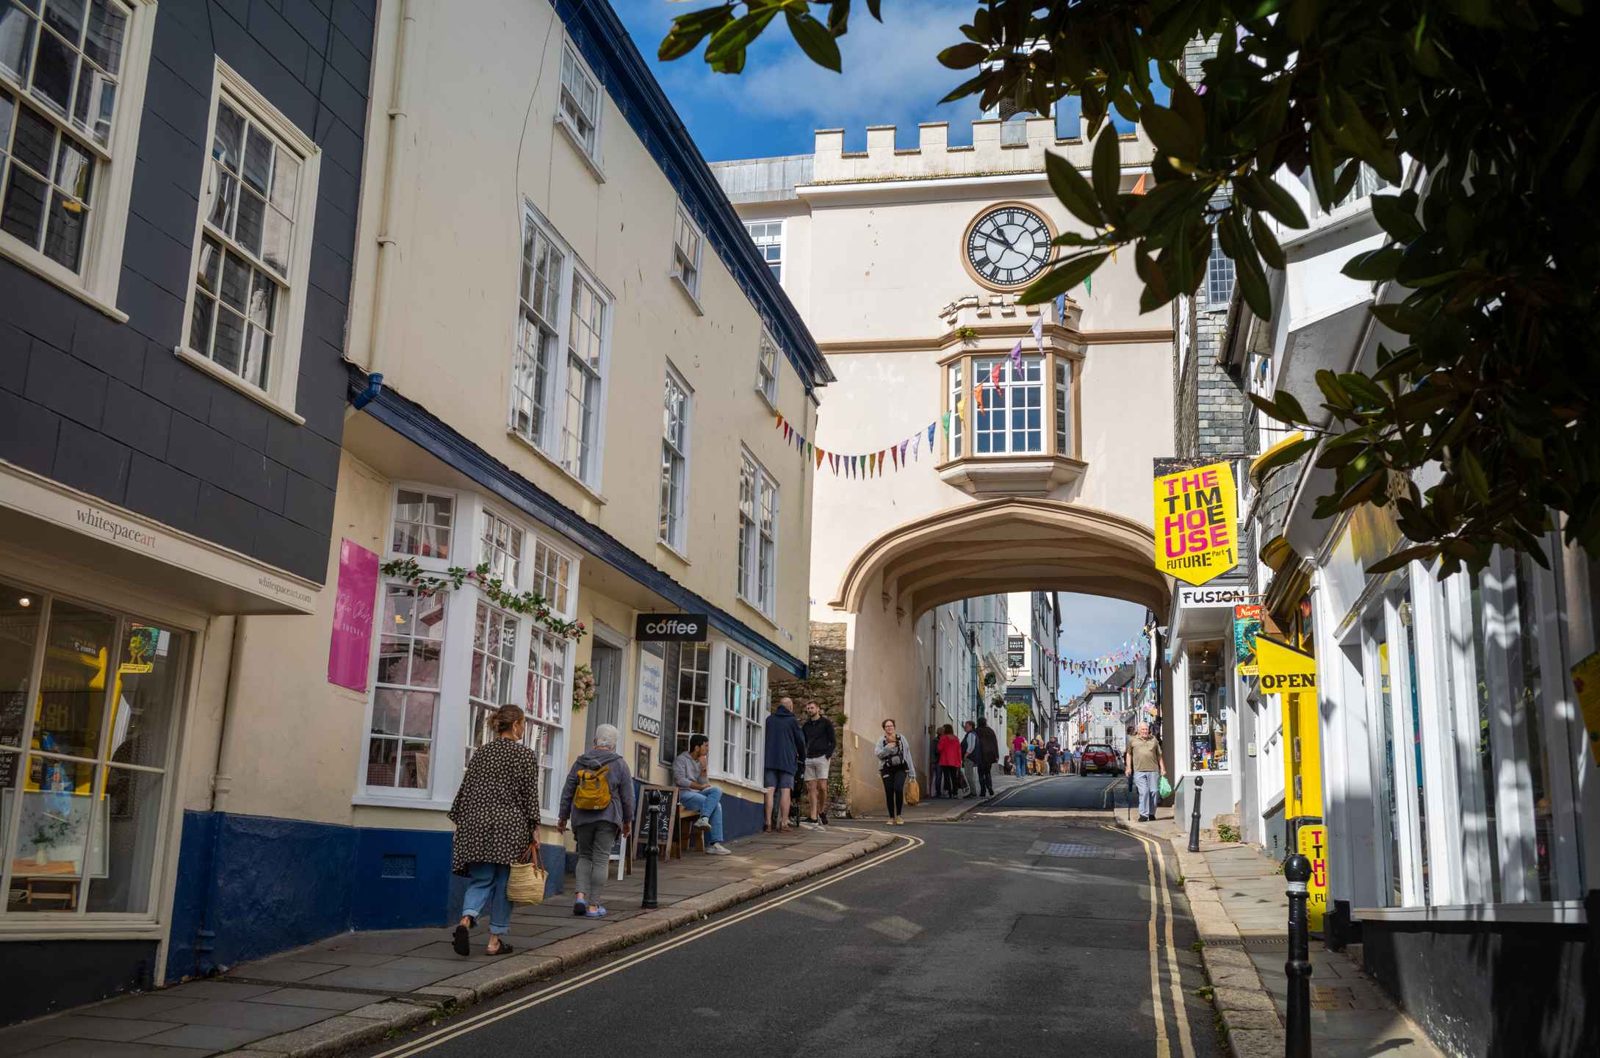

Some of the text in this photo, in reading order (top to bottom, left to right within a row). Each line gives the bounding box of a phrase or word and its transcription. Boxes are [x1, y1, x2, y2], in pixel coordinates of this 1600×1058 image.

[1163, 470, 1218, 496] THE
[1163, 486, 1223, 515] TIM
[76, 508, 156, 549] whitespaceart
[1165, 524, 1230, 558] USE
[1166, 552, 1212, 570] FUTURE
[1226, 547, 1233, 564] 1
[1182, 590, 1244, 604] FUSION
[645, 620, 698, 635] coffee
[1261, 674, 1315, 689] OPEN
